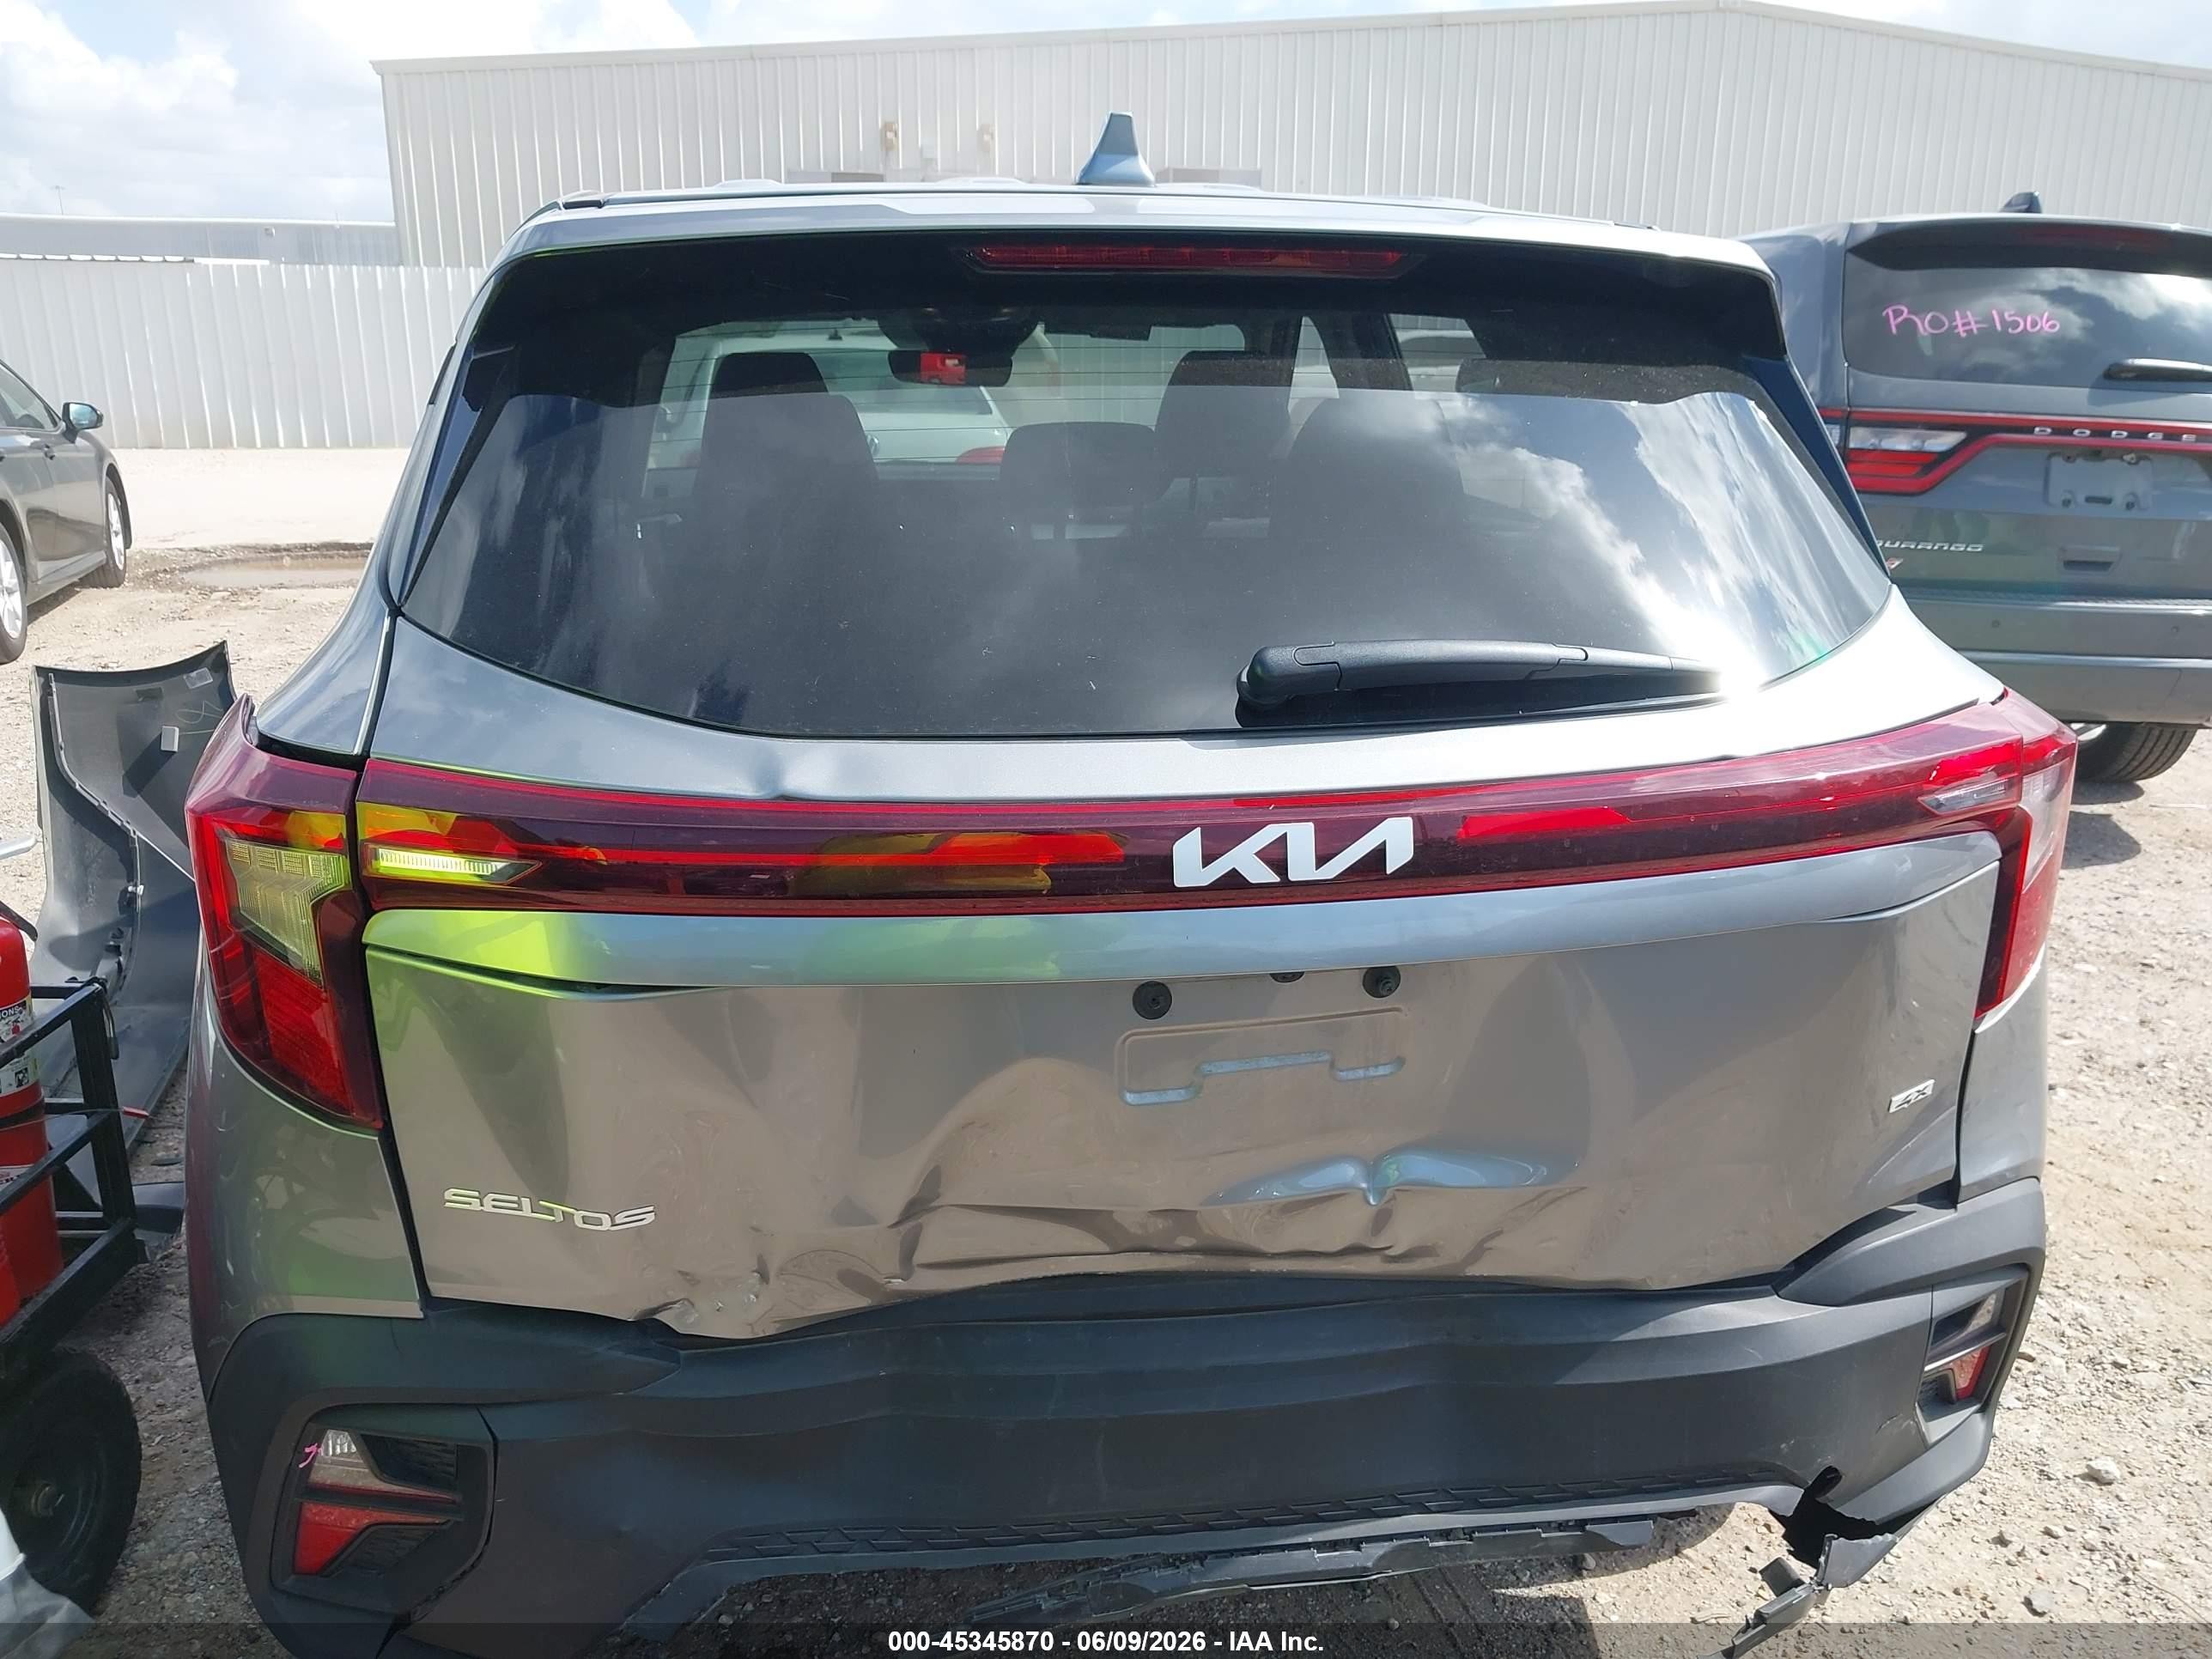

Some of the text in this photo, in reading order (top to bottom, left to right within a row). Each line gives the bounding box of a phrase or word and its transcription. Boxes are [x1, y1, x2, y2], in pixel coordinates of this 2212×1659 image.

[2033, 427, 2197, 442] DODGE
[1173, 817, 1413, 887] KIA
[443, 1188, 655, 1231] SELTOS
